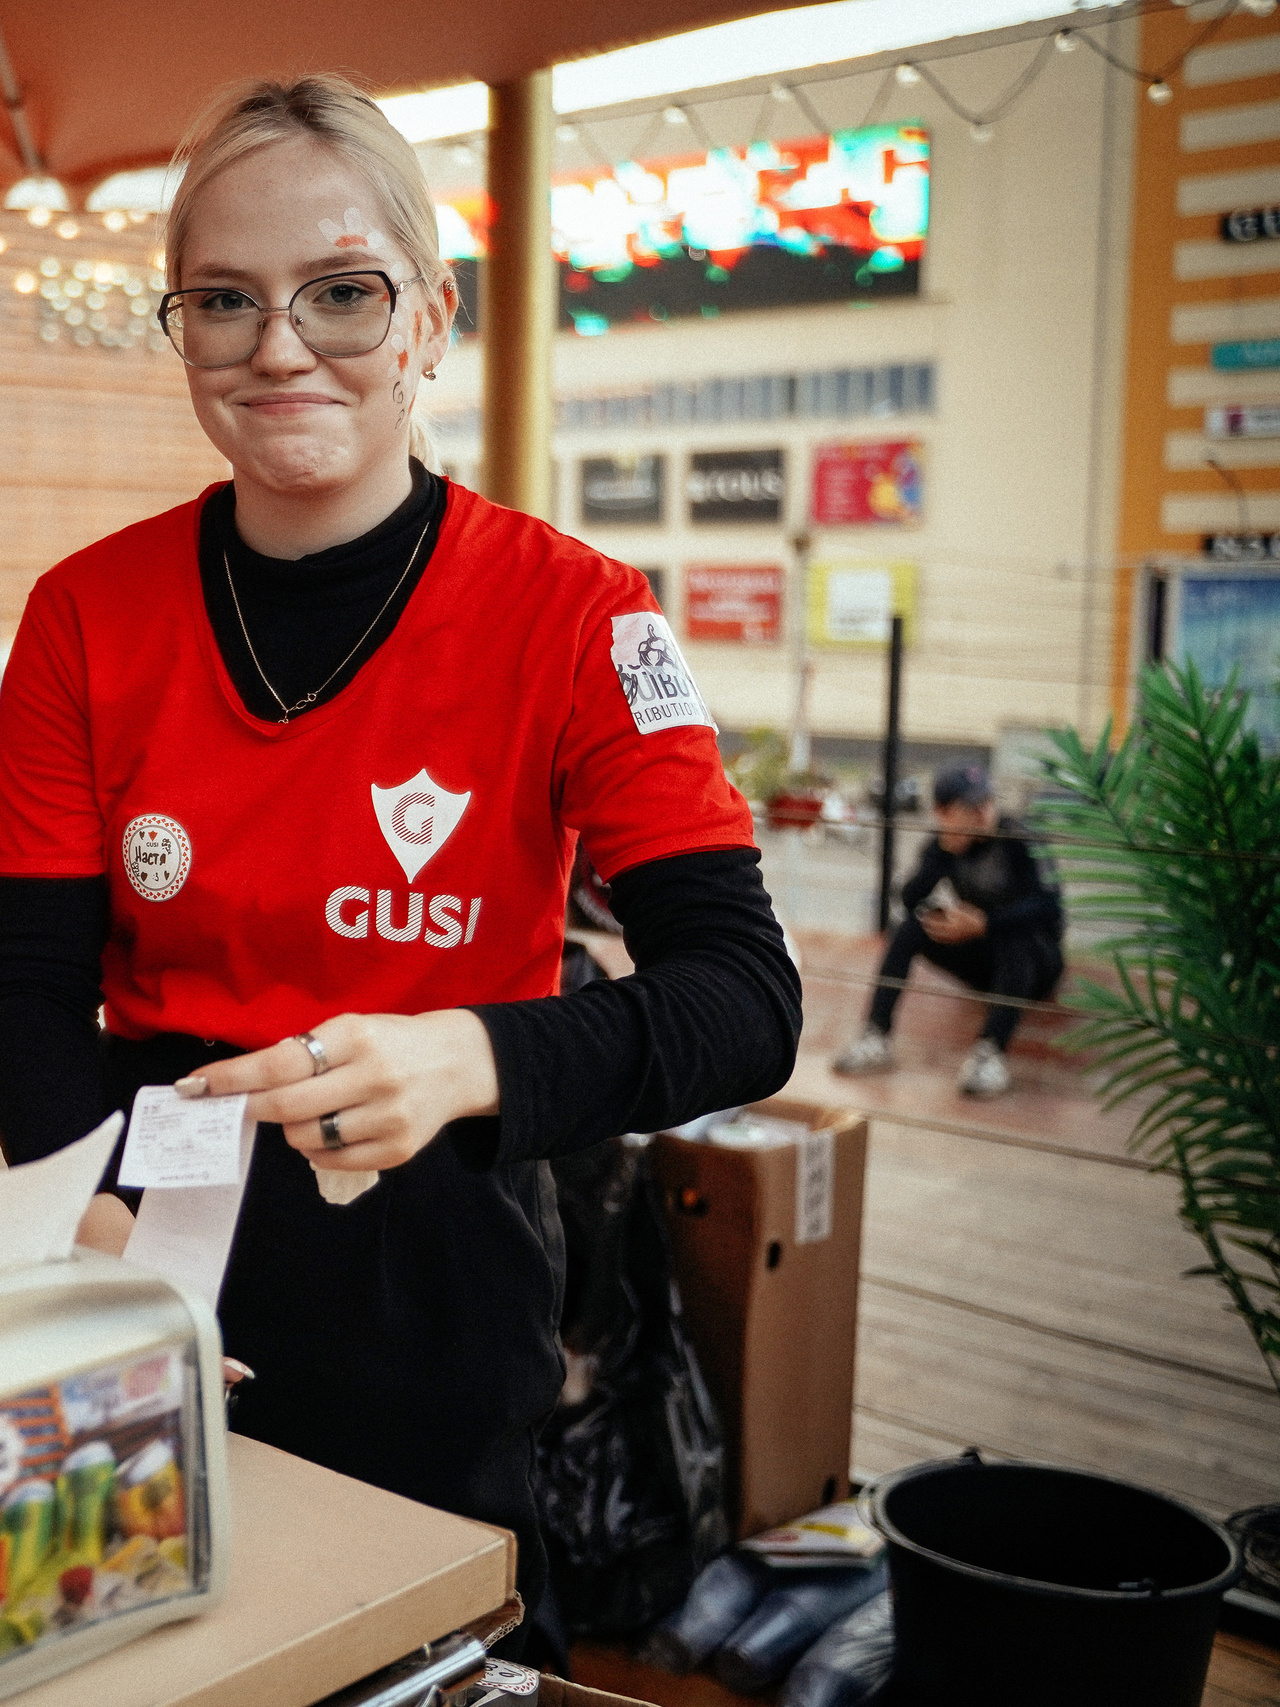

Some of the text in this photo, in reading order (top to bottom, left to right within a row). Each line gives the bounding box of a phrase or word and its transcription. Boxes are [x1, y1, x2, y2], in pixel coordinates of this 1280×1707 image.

[391, 791, 437, 846] G
[135, 845, 167, 866] Настя
[324, 885, 483, 950] GUSI
